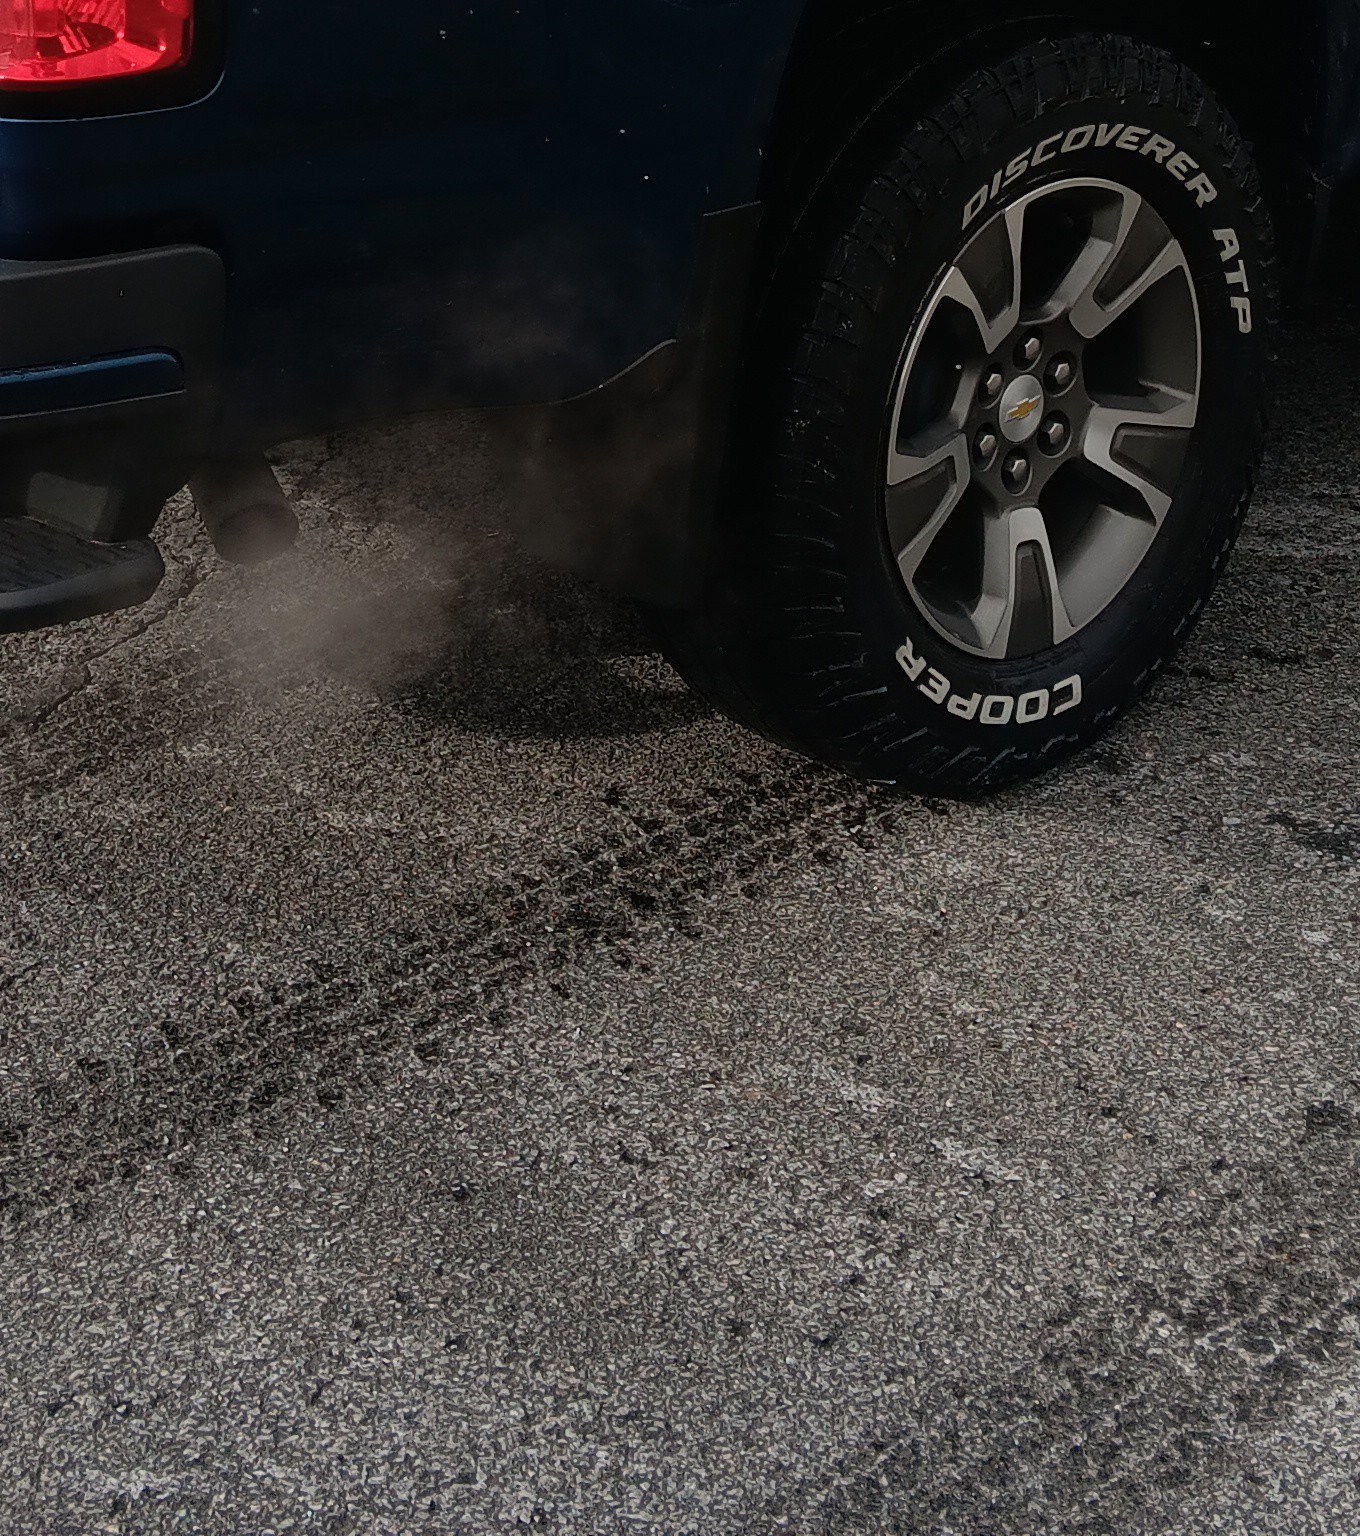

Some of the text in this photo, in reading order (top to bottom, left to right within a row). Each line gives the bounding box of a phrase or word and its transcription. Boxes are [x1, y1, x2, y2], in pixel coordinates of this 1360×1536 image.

[961, 122, 1253, 334] DISCOVERER ATP
[895, 635, 1083, 726] COOPER
